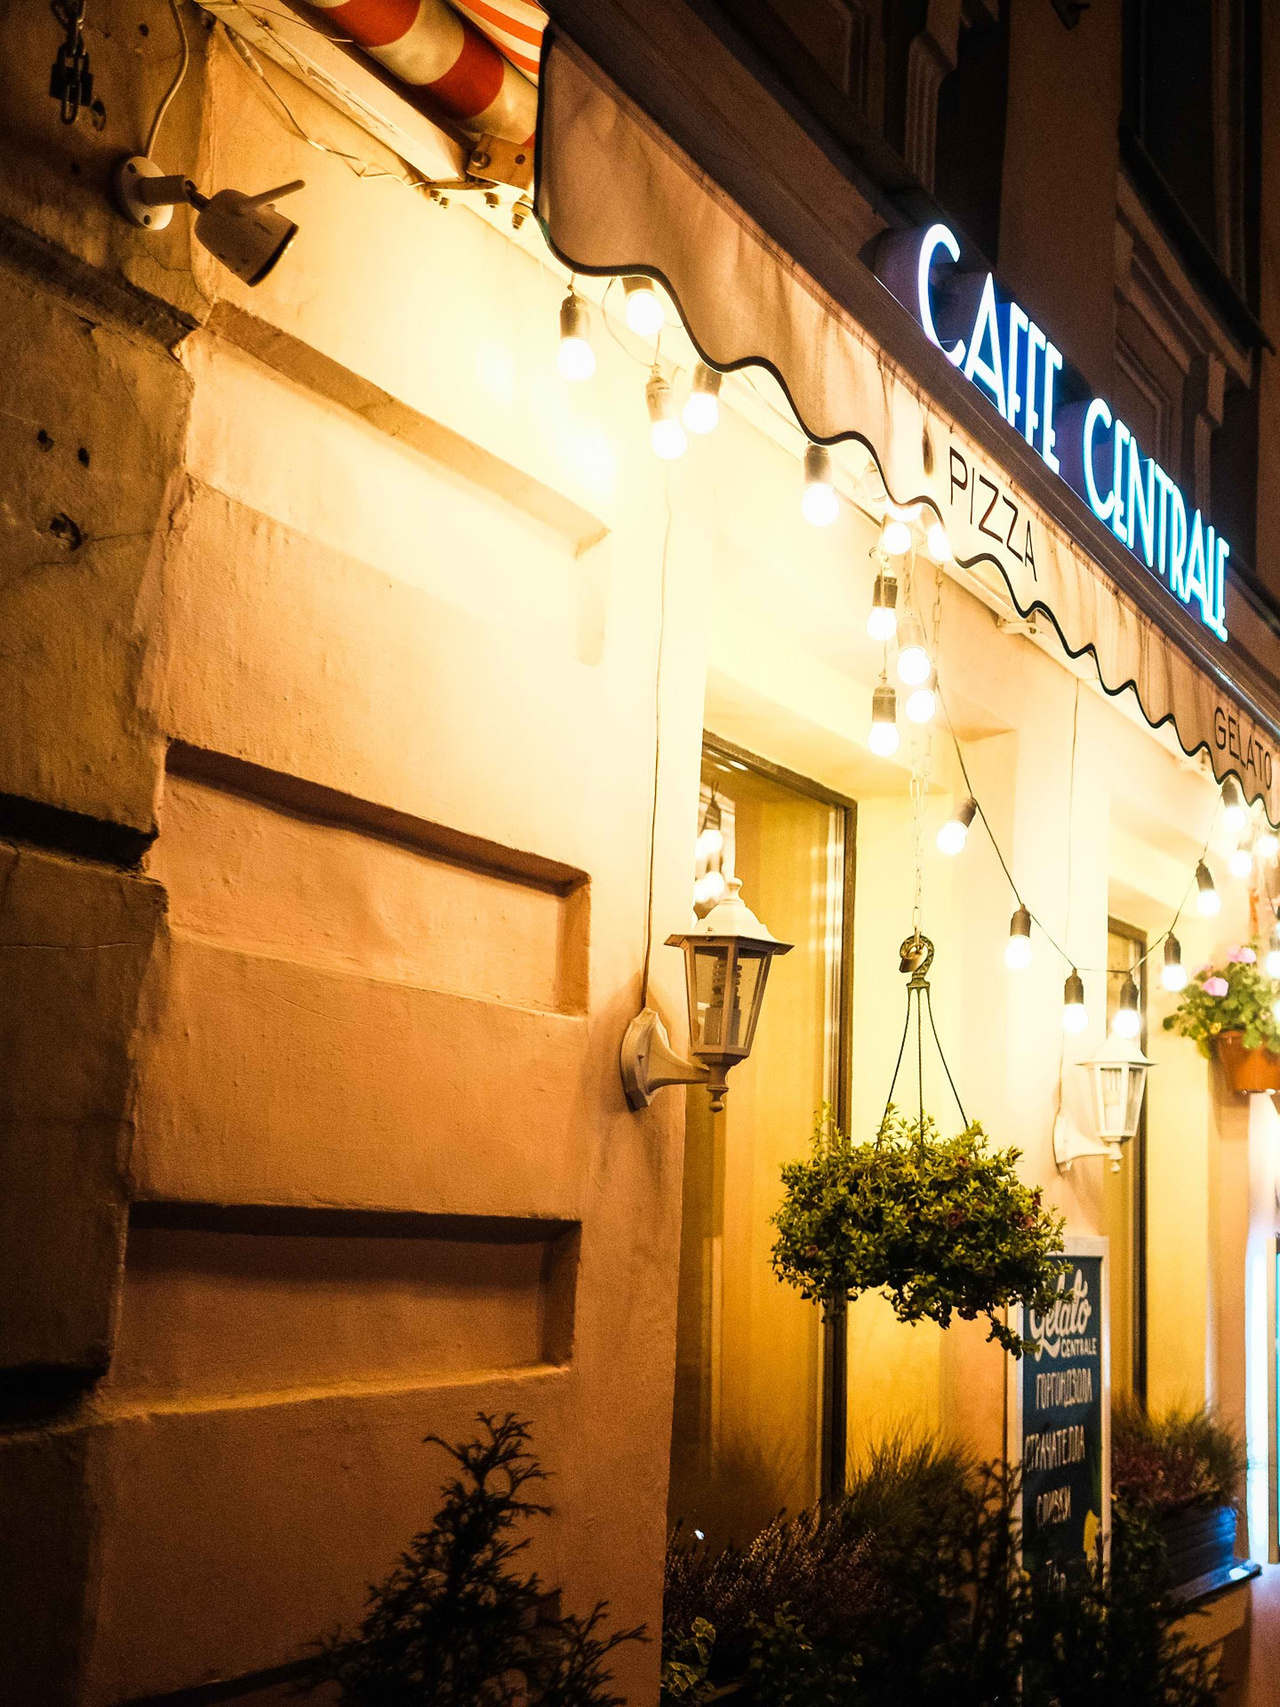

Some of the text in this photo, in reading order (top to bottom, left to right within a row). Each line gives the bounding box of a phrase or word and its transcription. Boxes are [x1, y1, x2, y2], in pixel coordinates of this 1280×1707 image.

[918, 223, 1229, 642] CAFFE CENTRALE
[949, 446, 1037, 582] PIZZA
[1215, 707, 1272, 790] GELATO
[1061, 1337, 1097, 1358] CENTRALE
